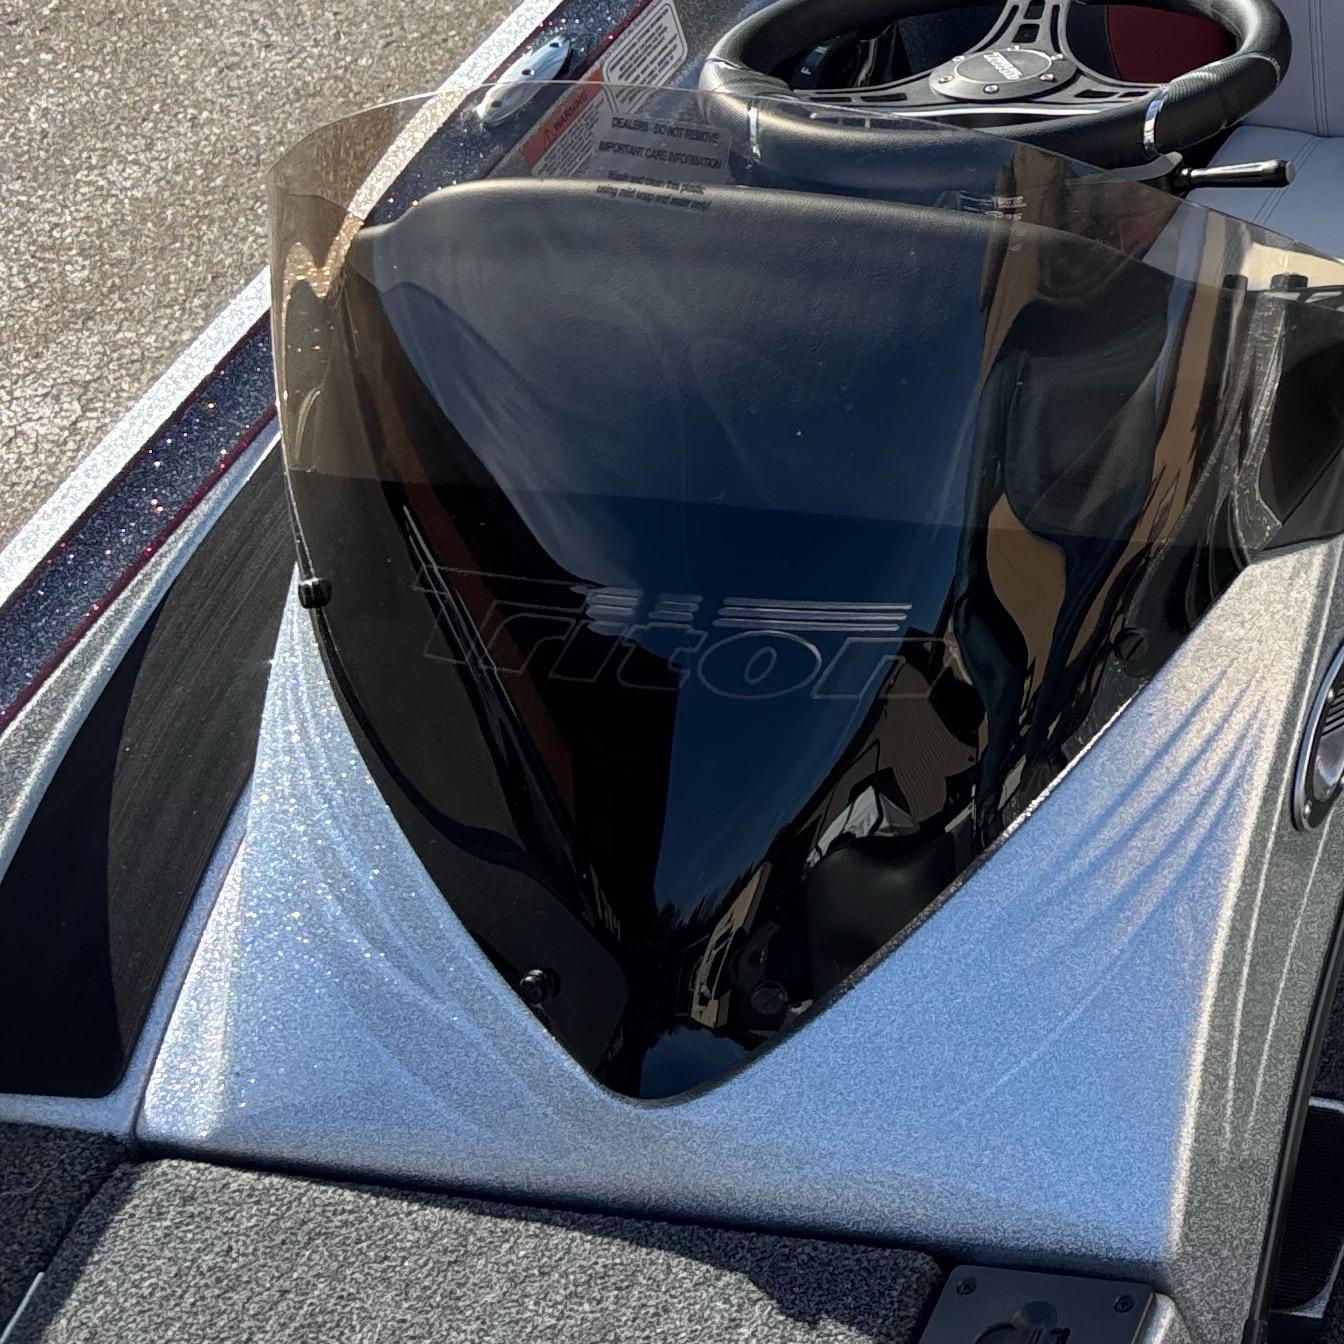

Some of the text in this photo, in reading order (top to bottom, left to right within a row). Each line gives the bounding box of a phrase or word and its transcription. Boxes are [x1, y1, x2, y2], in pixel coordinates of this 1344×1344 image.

[611, 116, 648, 132] DEALERS
[667, 126, 685, 138] NOT
[685, 128, 720, 144] REMOVE
[599, 140, 722, 169] IMPORTANT CARE INFORMATION
